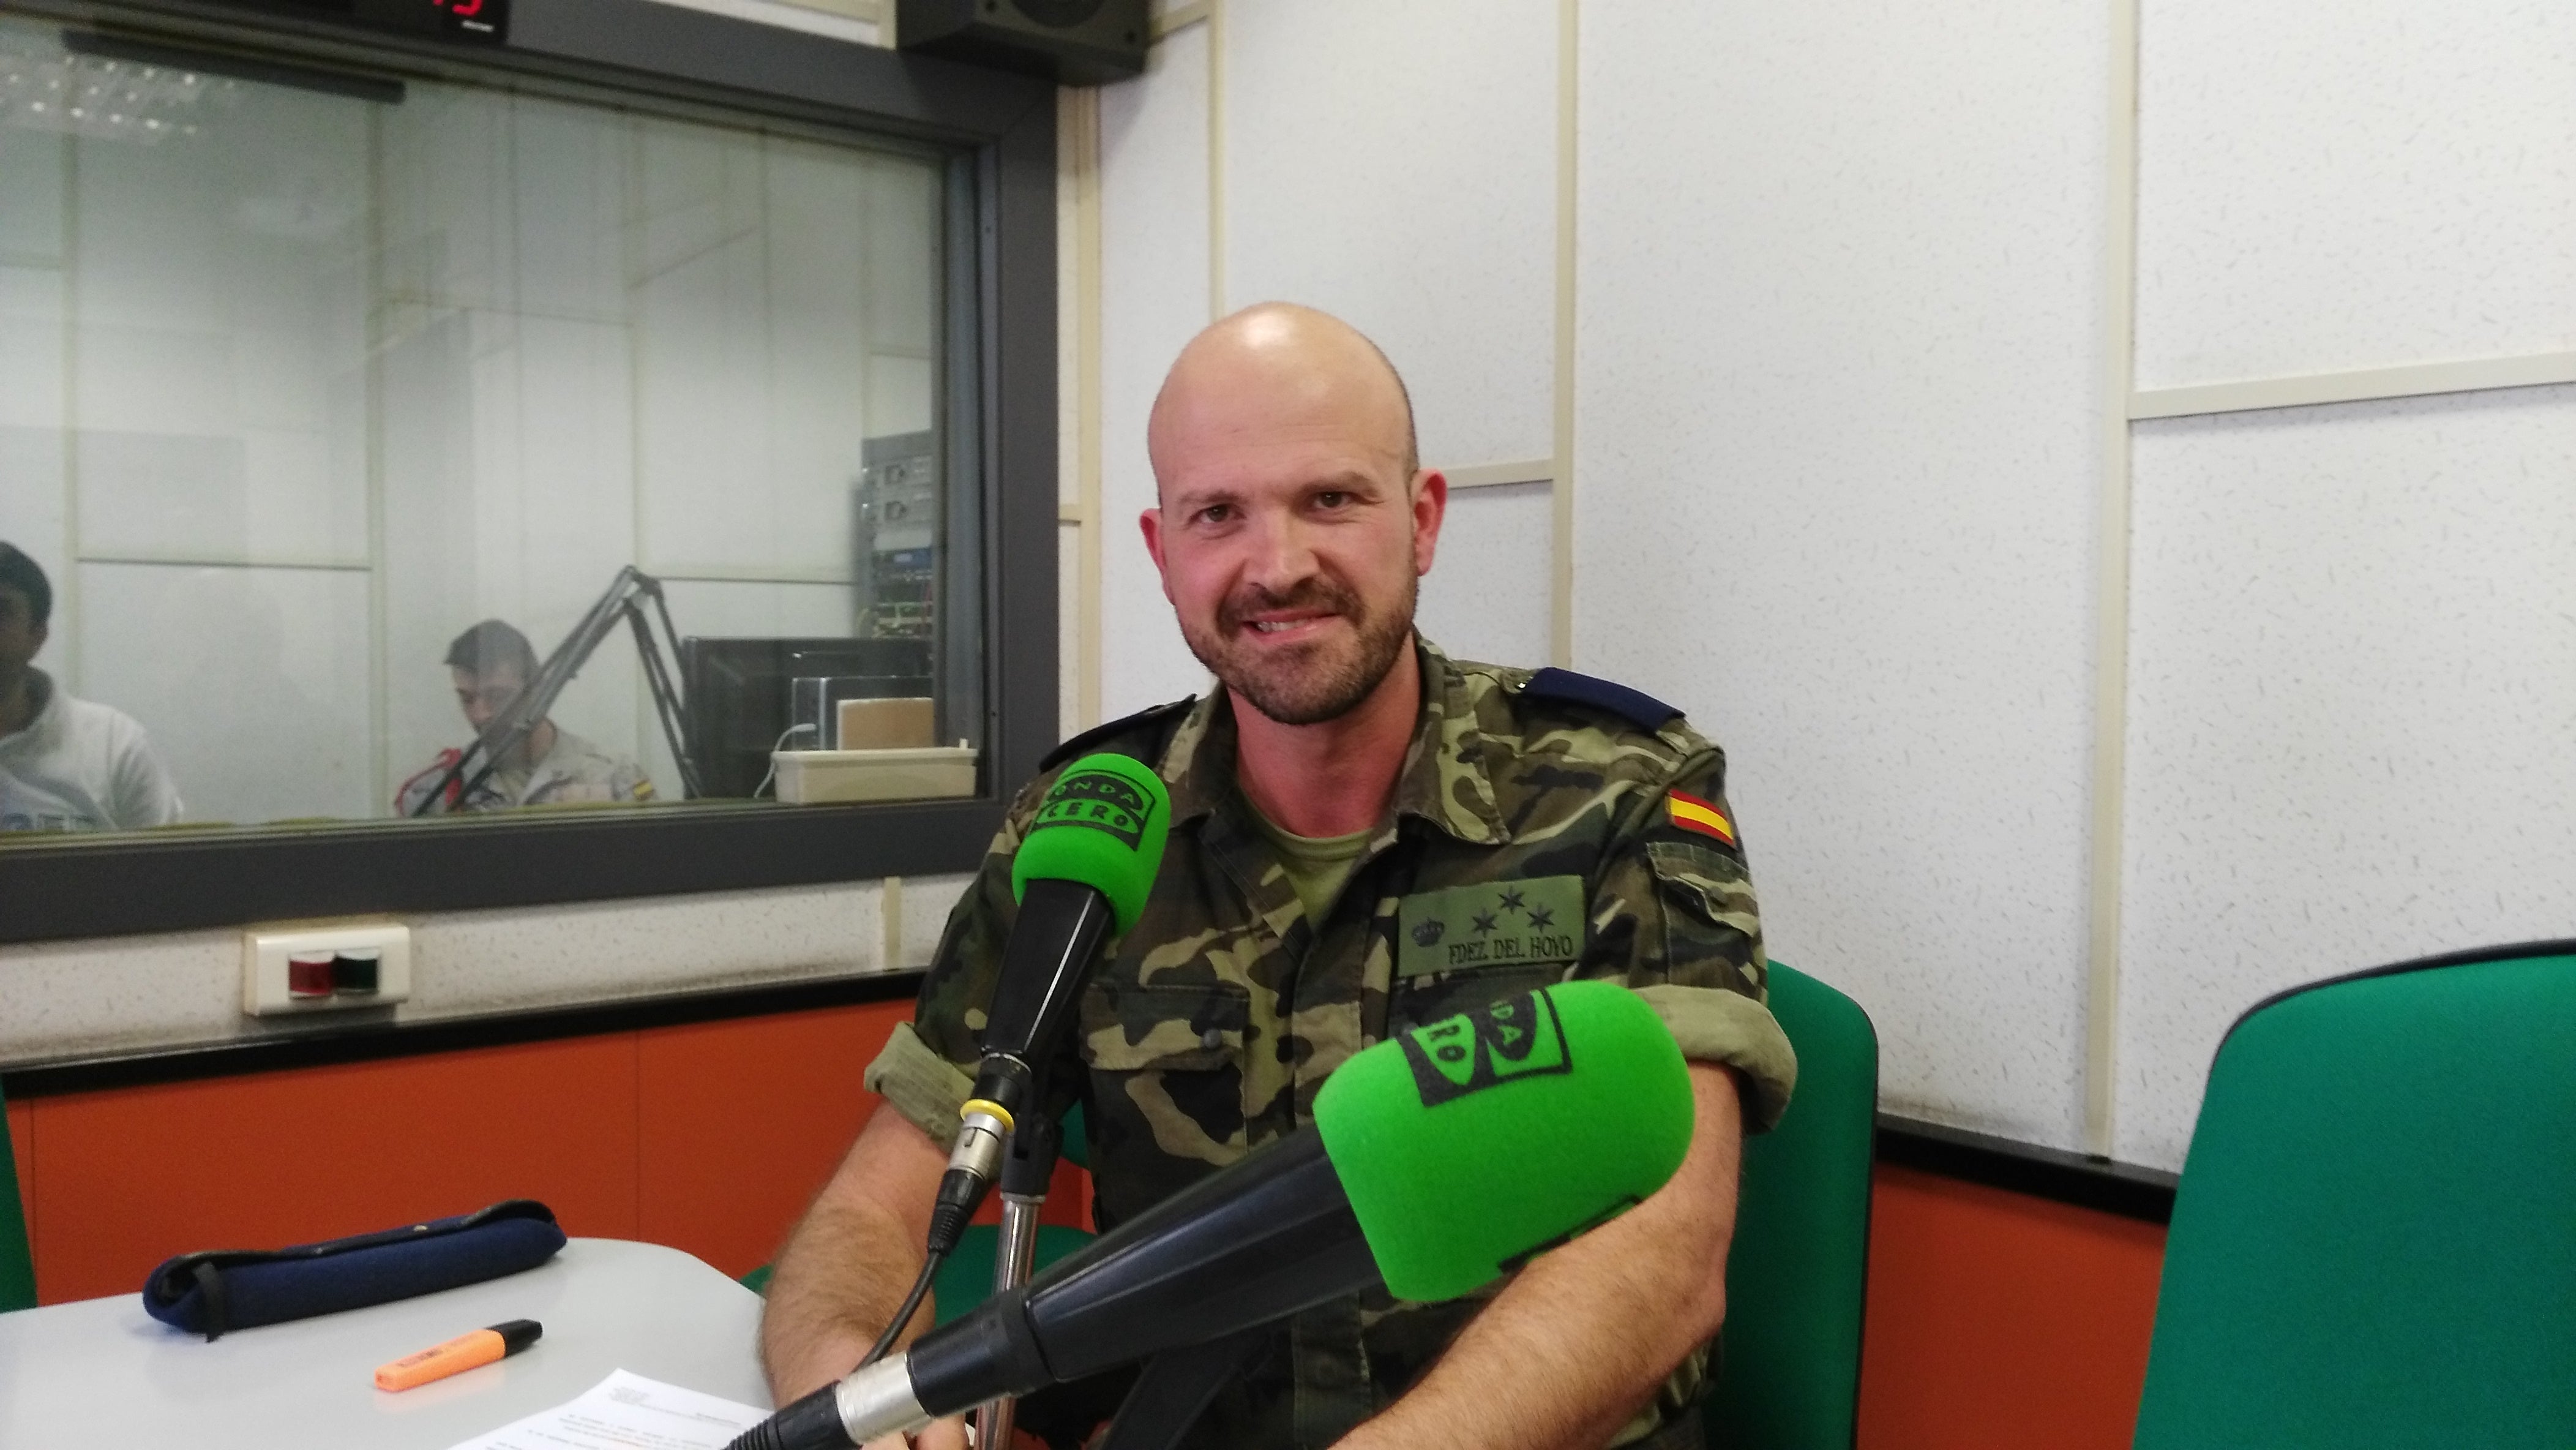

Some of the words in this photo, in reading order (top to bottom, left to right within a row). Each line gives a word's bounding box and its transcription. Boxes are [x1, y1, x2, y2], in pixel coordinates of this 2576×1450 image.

[1054, 781, 1133, 804] ONDA
[1047, 802, 1128, 826] CERO
[1493, 937, 1526, 959] DEL
[1530, 934, 1573, 958] HOYO
